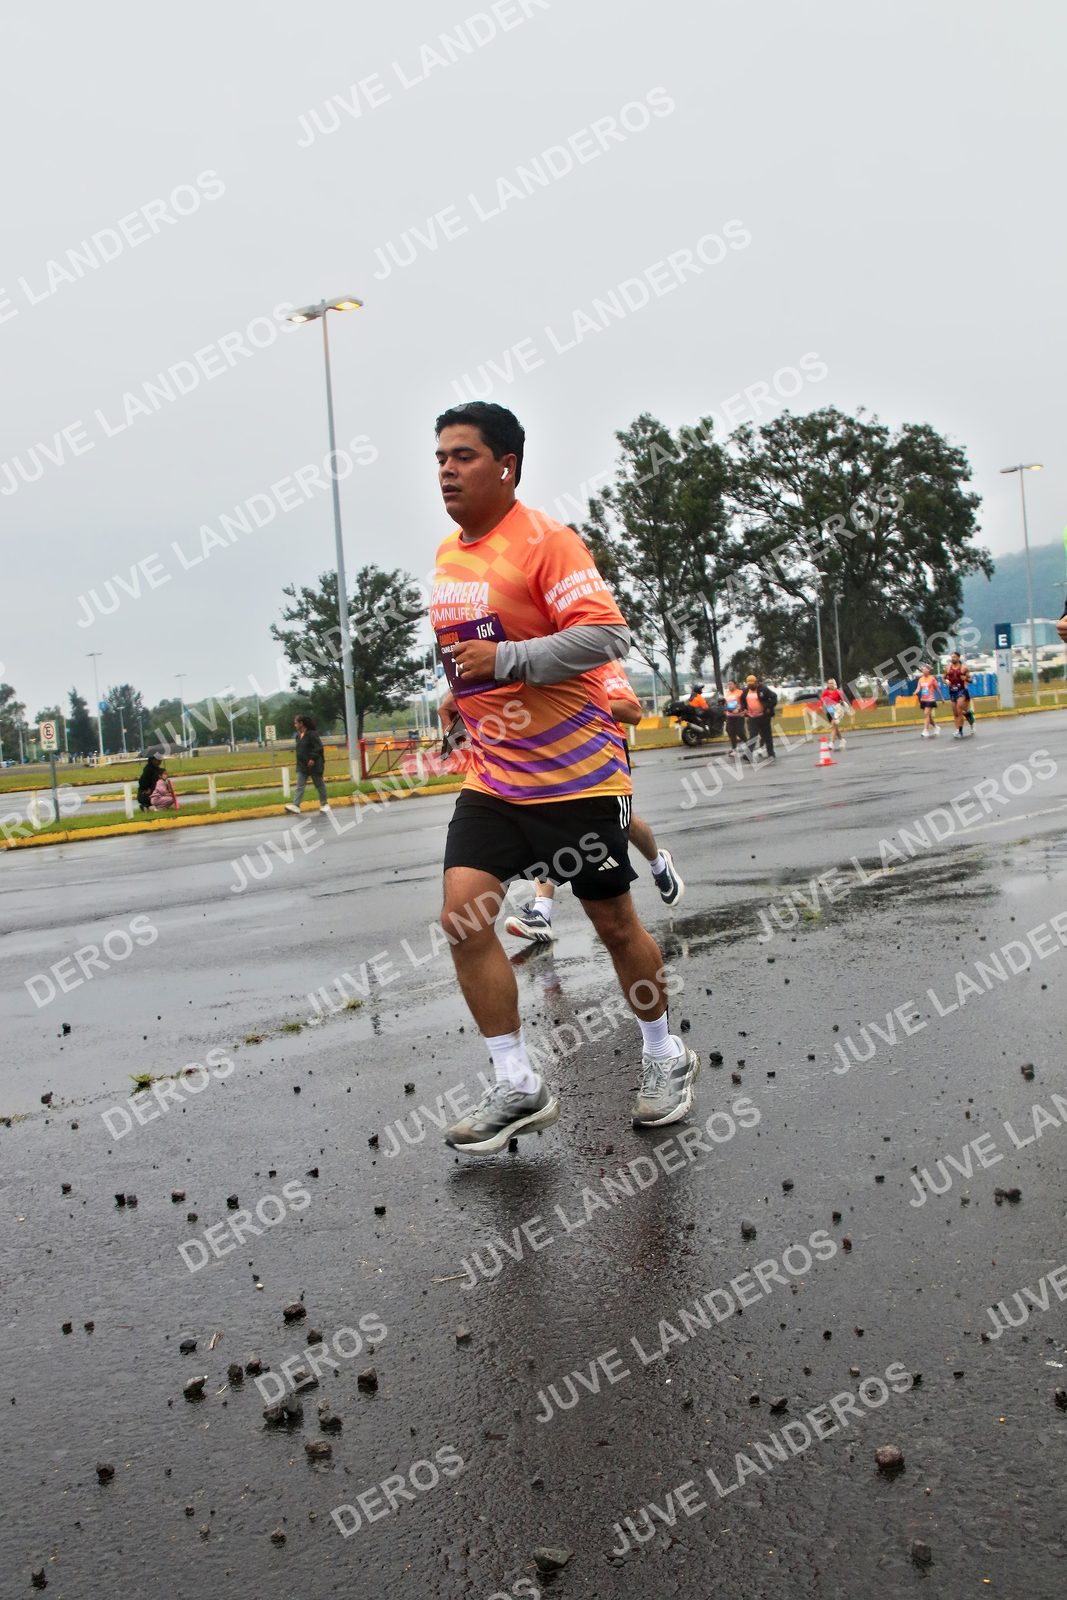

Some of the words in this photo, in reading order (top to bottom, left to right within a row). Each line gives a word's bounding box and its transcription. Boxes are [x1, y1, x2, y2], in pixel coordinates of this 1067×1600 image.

[432, 581, 489, 607] CARRERA
[430, 607, 471, 625] OMNILIFE
[476, 621, 496, 640] 15K
[998, 633, 1008, 646] E
